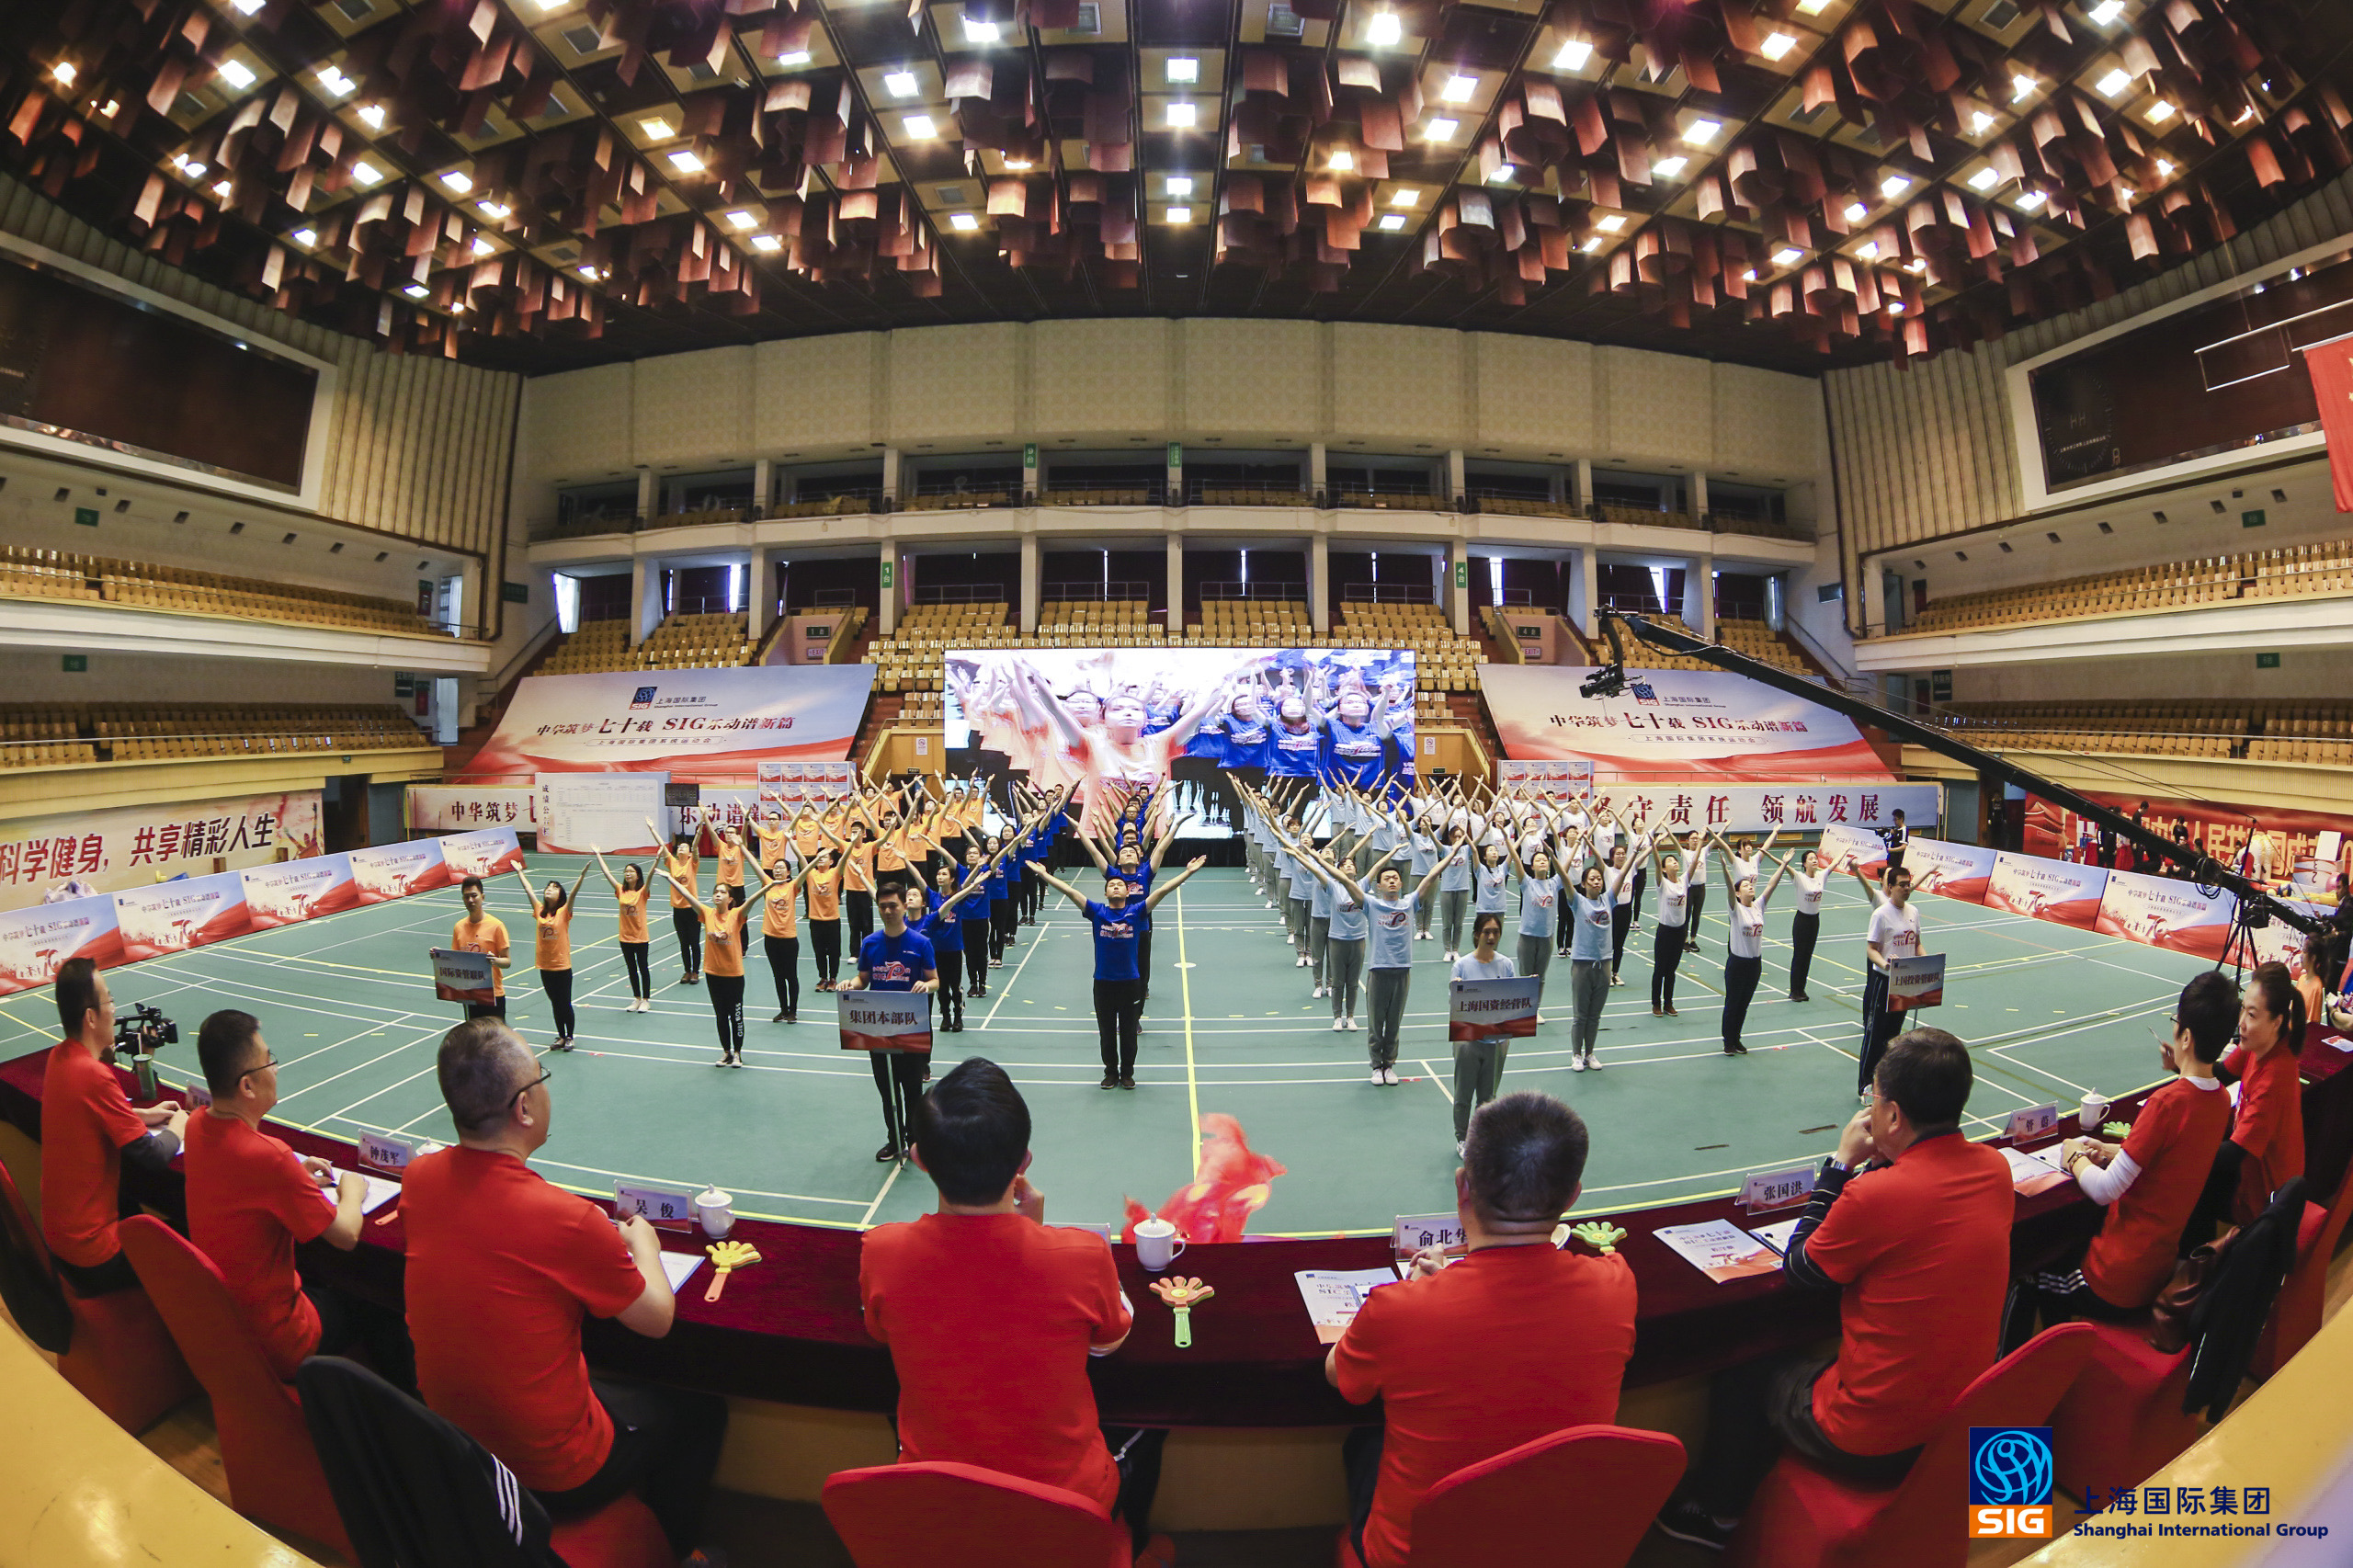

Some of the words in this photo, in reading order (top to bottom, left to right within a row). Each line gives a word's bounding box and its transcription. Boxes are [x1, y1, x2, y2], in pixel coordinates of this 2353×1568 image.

[655, 696, 707, 705] 上海国际集团
[1663, 696, 1711, 704] 上海国际集团
[537, 716, 654, 736] 中华筑梦七十载
[1550, 712, 1688, 730] 中华筑梦七十载
[1760, 793, 1880, 825] 领航发展
[129, 812, 276, 867] 共享精彩人生
[1457, 997, 1532, 1012] 上海国资经营队
[848, 1009, 918, 1026] 集团本部队
[1764, 1180, 1803, 1200] 张国洪
